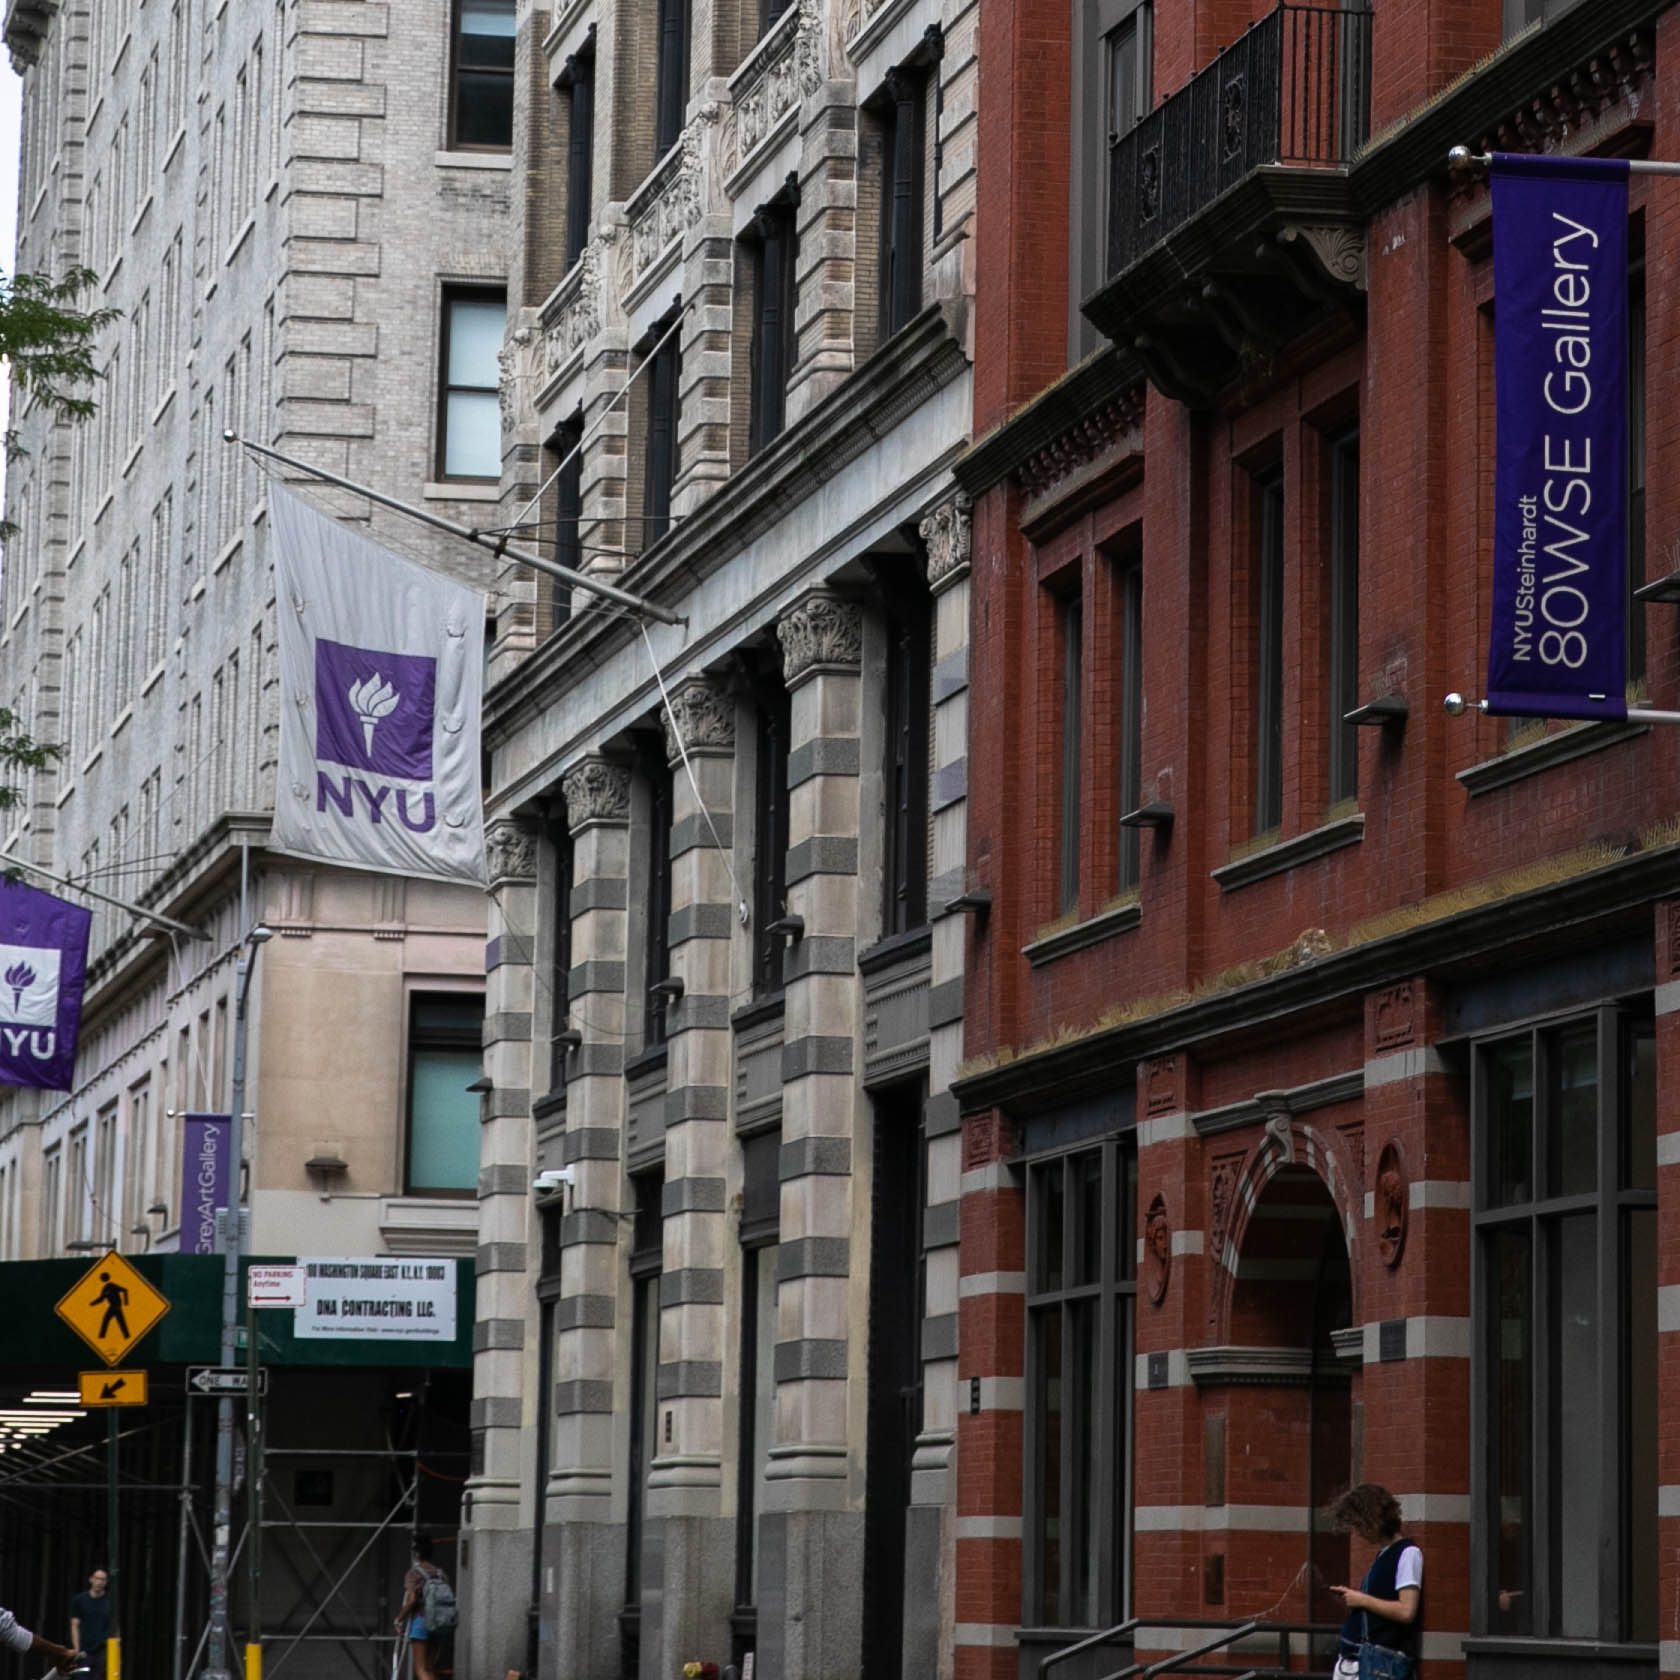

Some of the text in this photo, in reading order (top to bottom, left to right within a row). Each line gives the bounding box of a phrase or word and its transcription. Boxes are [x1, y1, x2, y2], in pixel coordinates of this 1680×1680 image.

[1541, 212, 1599, 414] Gallery
[1513, 495, 1537, 661] NYUSteinhardt
[316, 770, 436, 833] NYU
[341, 1300, 413, 1318] CONTRACTING
